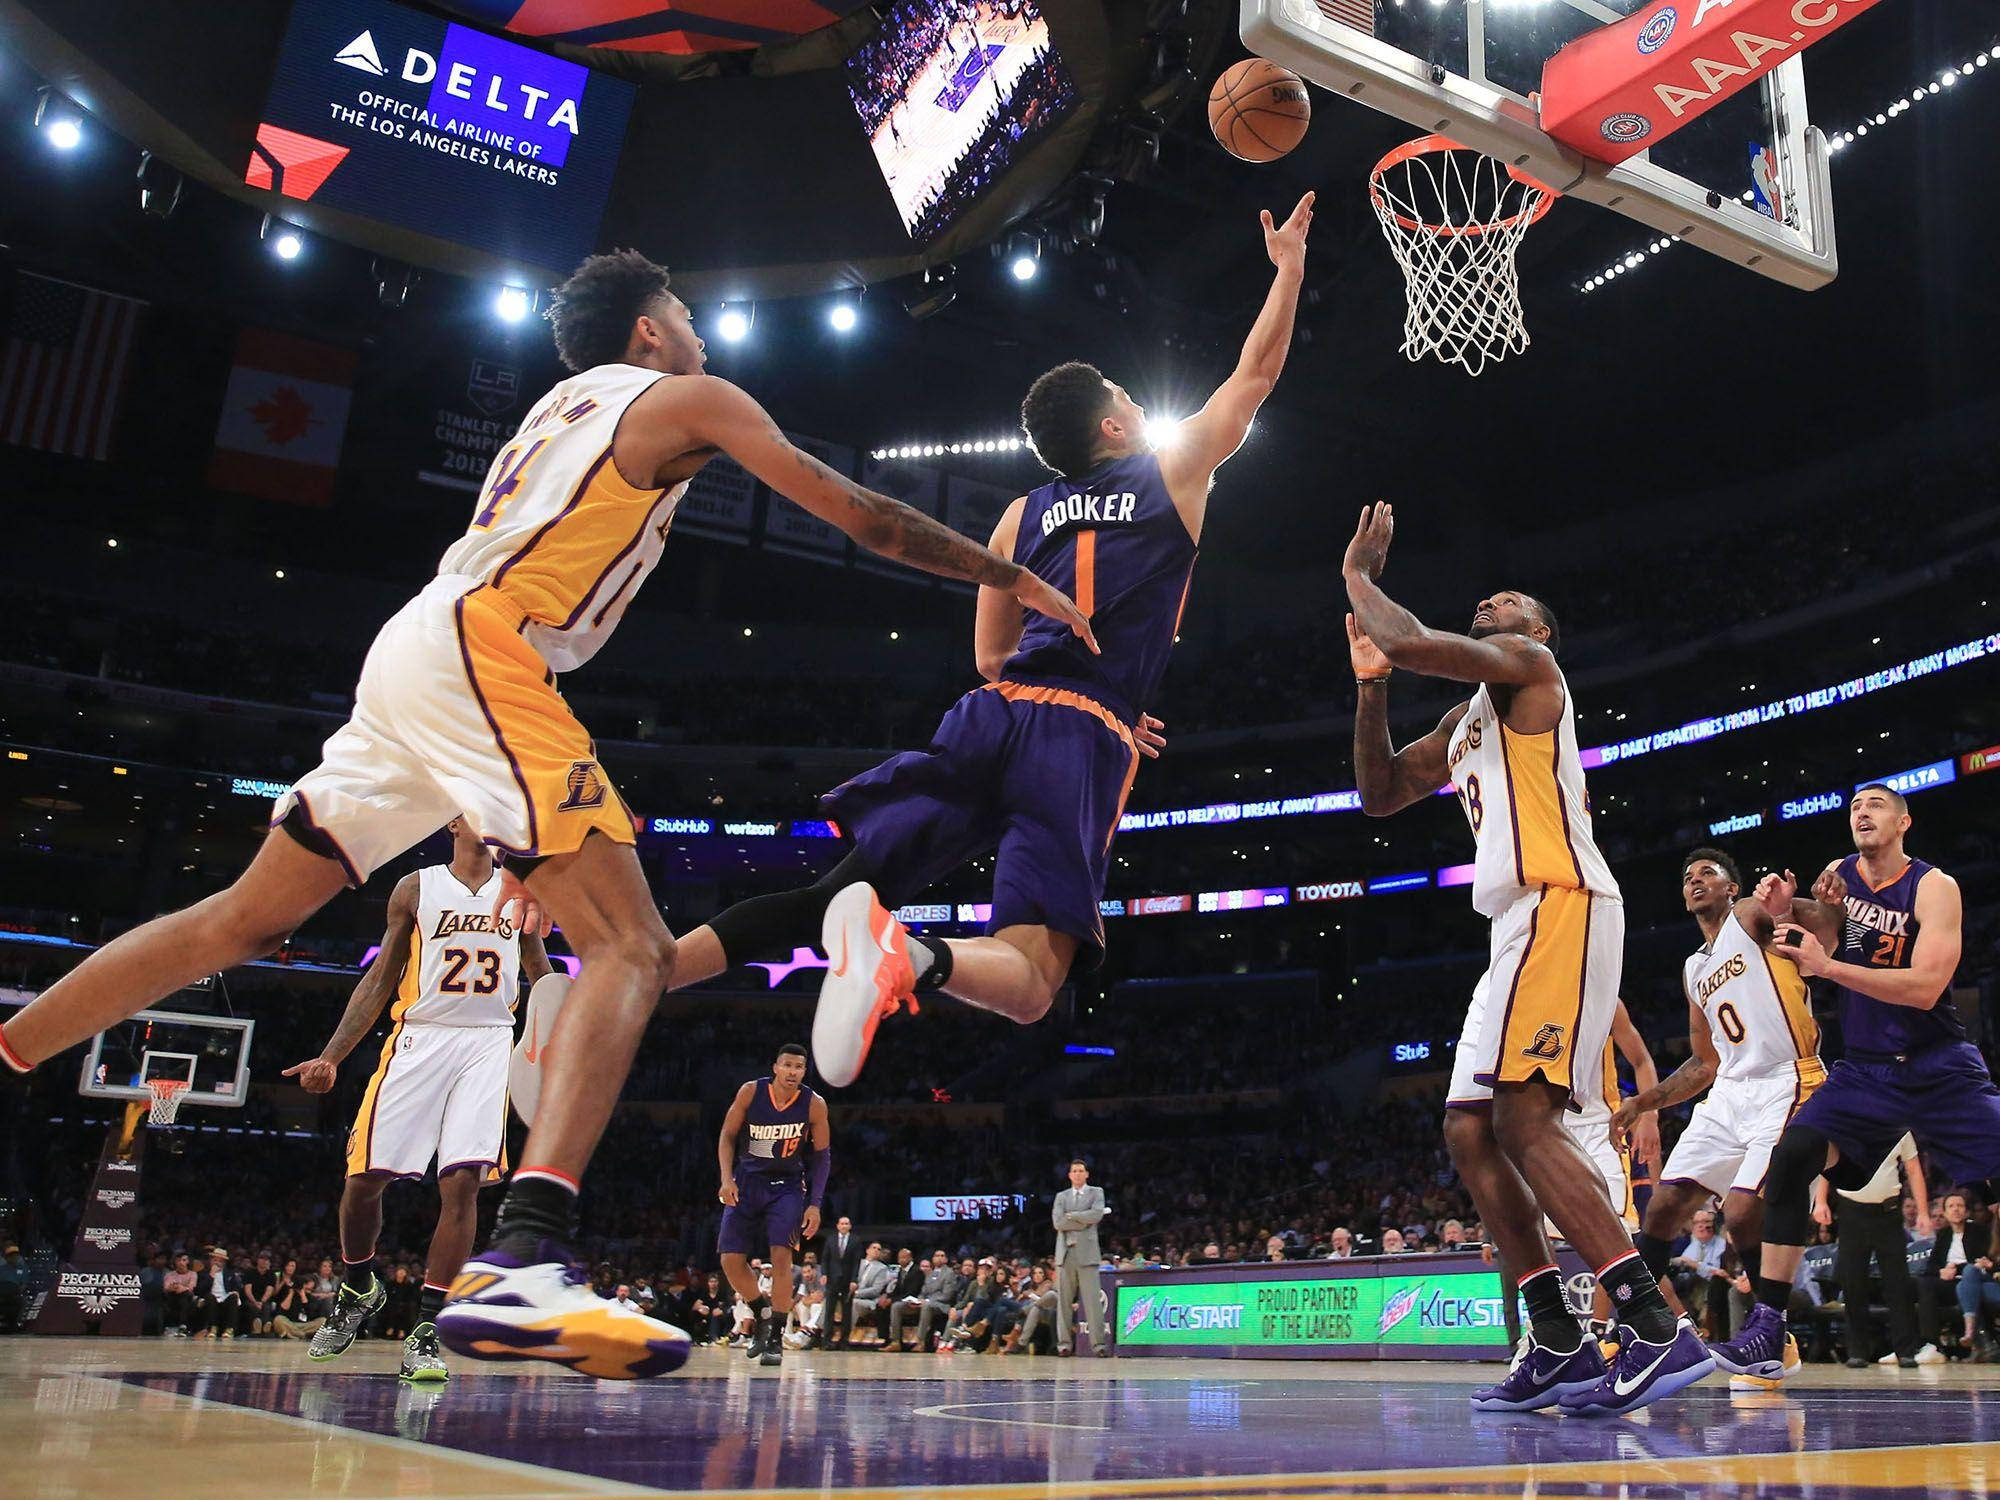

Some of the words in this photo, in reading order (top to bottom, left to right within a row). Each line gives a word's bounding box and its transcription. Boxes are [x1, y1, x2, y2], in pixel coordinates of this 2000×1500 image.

[1648, 20, 1667, 38] AAA
[1653, 0, 1863, 117] AAA.C
[401, 48, 580, 135] DELTA
[358, 90, 440, 130] OFFICIAL
[445, 117, 513, 153] AIRLINE
[518, 140, 543, 160] OF
[330, 102, 366, 128] THE
[370, 116, 405, 141] LOS
[409, 128, 490, 167] ANGELES
[493, 153, 559, 187] LAKERS
[436, 409, 500, 437] STANLEY
[472, 434, 552, 533] 4
[1041, 492, 1136, 537] BOOKER
[1075, 530, 1096, 619] 1
[1621, 736, 1652, 759] DAILY
[1653, 718, 1725, 751] DEPARTURES
[1725, 708, 1760, 731] FROM
[1761, 700, 1785, 722] LAX
[1785, 695, 1805, 714] TO
[1806, 686, 1838, 710] HELP
[1837, 677, 1865, 700] YOU
[1864, 664, 1907, 693] BREAK
[1907, 652, 1944, 679] AWAY
[1945, 638, 1985, 667] MORE
[232, 778, 256, 792] SAN
[653, 818, 710, 834] StubHub
[724, 821, 776, 836] verizon
[1146, 811, 1169, 828] LAX
[1170, 810, 1187, 825] TO
[1187, 807, 1216, 824] HELP
[1215, 804, 1242, 821] YOU
[1242, 801, 1281, 818] BREAK
[1280, 797, 1316, 815] AWAY
[1315, 794, 1349, 812] MORE
[1709, 812, 1762, 837] verizon
[1782, 792, 1842, 820] StubHub
[1296, 882, 1364, 901] TOYOTA
[1871, 935, 1907, 967] 21
[440, 947, 501, 995] 23
[1717, 1001, 1746, 1045] 0
[749, 1122, 805, 1140] PHOENIX
[85, 1227, 132, 1237] PECHANGA
[58, 1286, 99, 1295] RESORT
[103, 1287, 141, 1296] CASINO
[59, 1273, 142, 1287] PECHANGA
[1152, 1296, 1245, 1330] KICKSTART
[1257, 1288, 1299, 1312] PROUD
[1302, 1286, 1359, 1311] PARTNER
[1262, 1315, 1277, 1339] OF
[1280, 1315, 1301, 1339] THE
[1306, 1313, 1353, 1339] LAKERS
